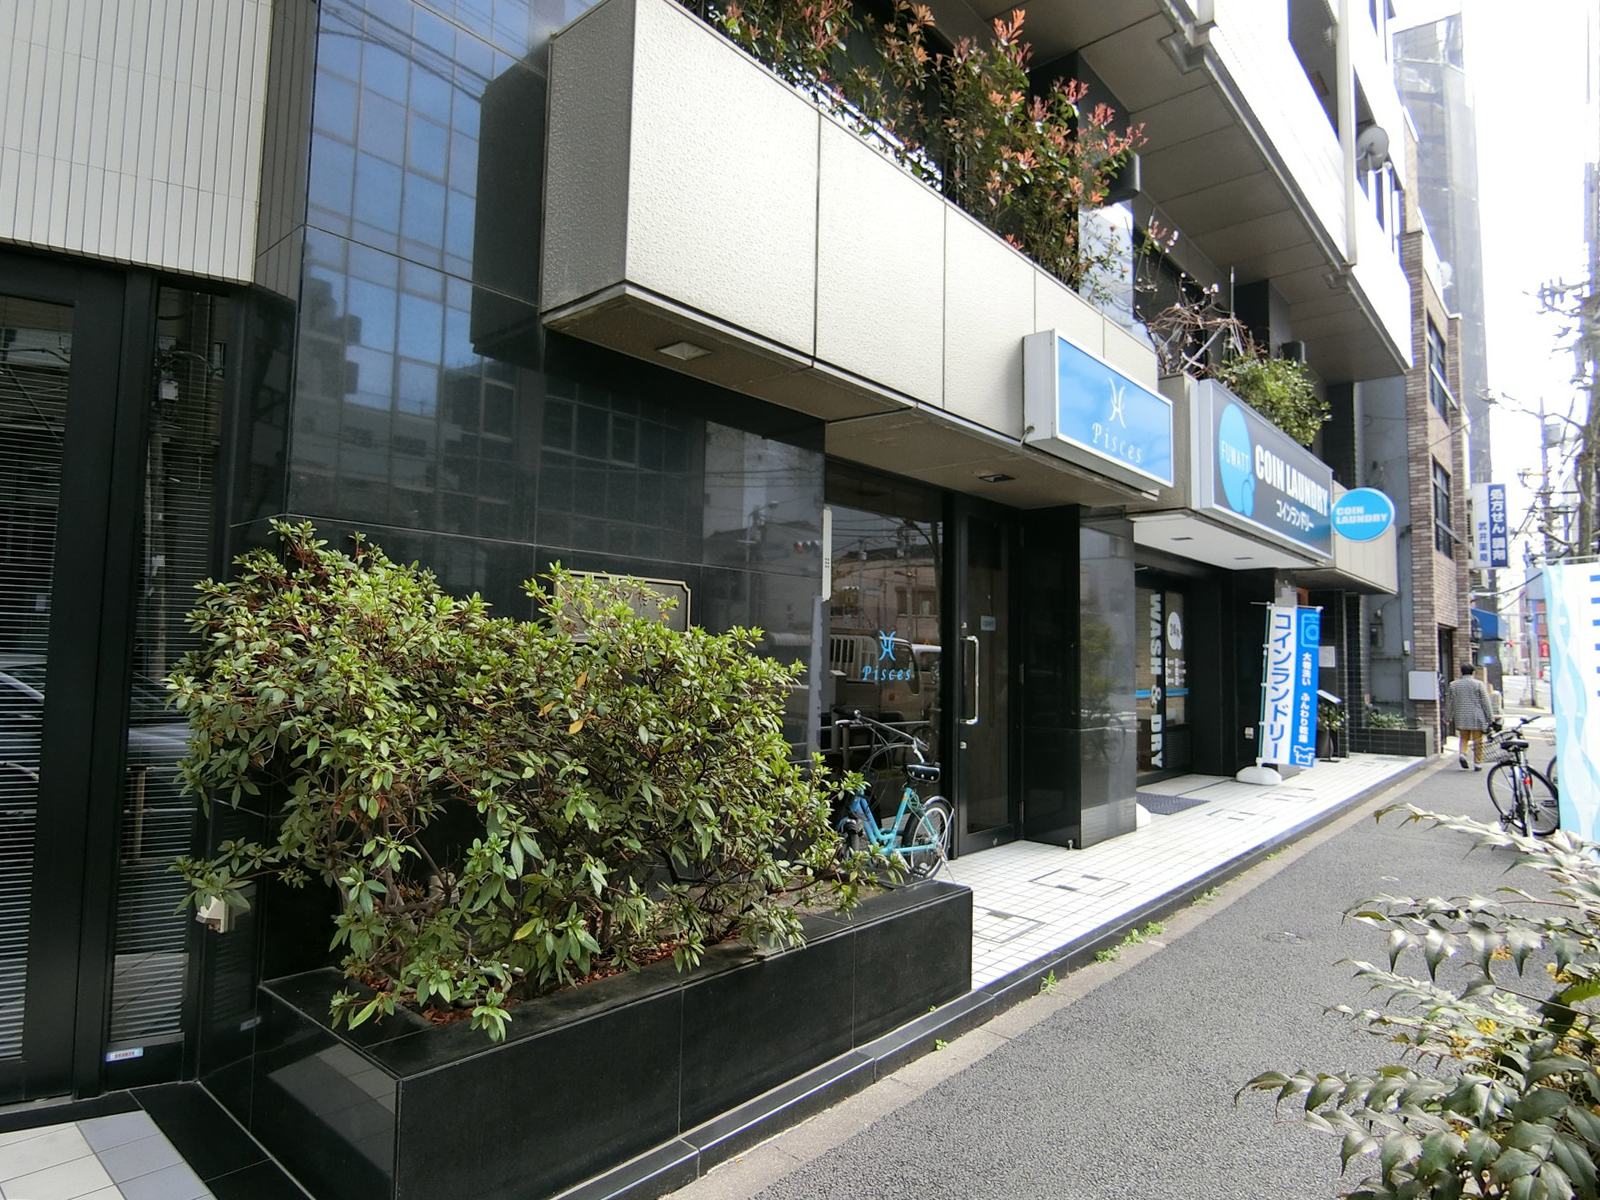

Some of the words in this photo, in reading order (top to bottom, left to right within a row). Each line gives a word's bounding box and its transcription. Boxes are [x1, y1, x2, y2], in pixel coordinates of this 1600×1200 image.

[1092, 422, 1142, 463] Pisces
[1255, 444, 1285, 492] COIN
[1286, 463, 1329, 517] LAUNDRY
[1276, 499, 1315, 532] コインランドリー
[1336, 506, 1364, 515] COIN
[1336, 513, 1388, 525] LAUNDRY
[1150, 593, 1162, 675] WASH
[862, 665, 911, 681] Pisces
[1270, 613, 1292, 759] コインランドリー
[1151, 685, 1162, 708] &
[1151, 714, 1163, 768] DRY
